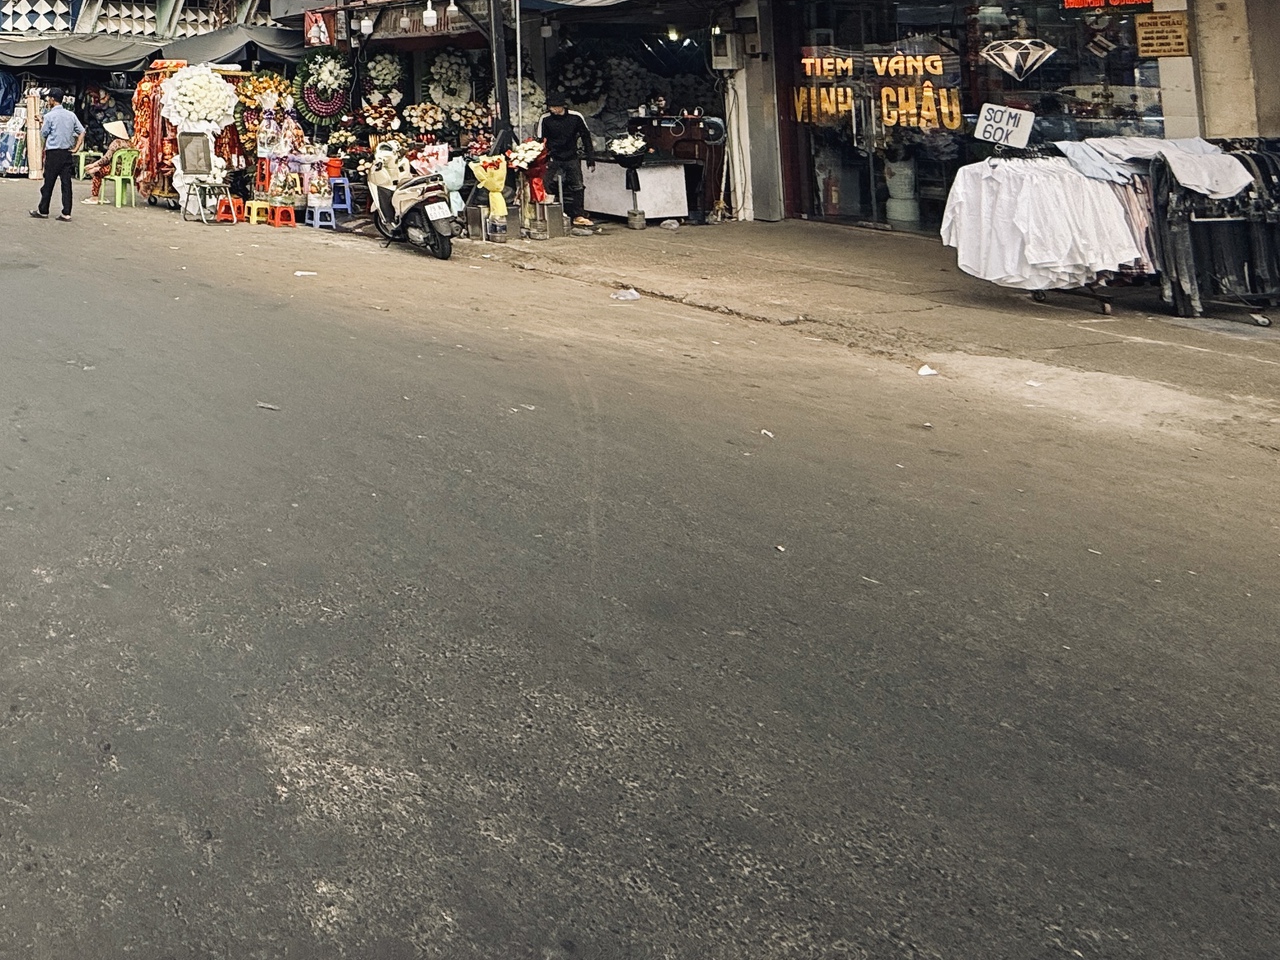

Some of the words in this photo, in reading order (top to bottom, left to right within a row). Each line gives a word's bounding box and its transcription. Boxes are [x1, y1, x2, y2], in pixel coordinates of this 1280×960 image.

[801, 54, 854, 80] TIỆM
[872, 50, 944, 77] VÀNG
[881, 80, 963, 130] CHÂU
[982, 123, 1014, 144] 60K
